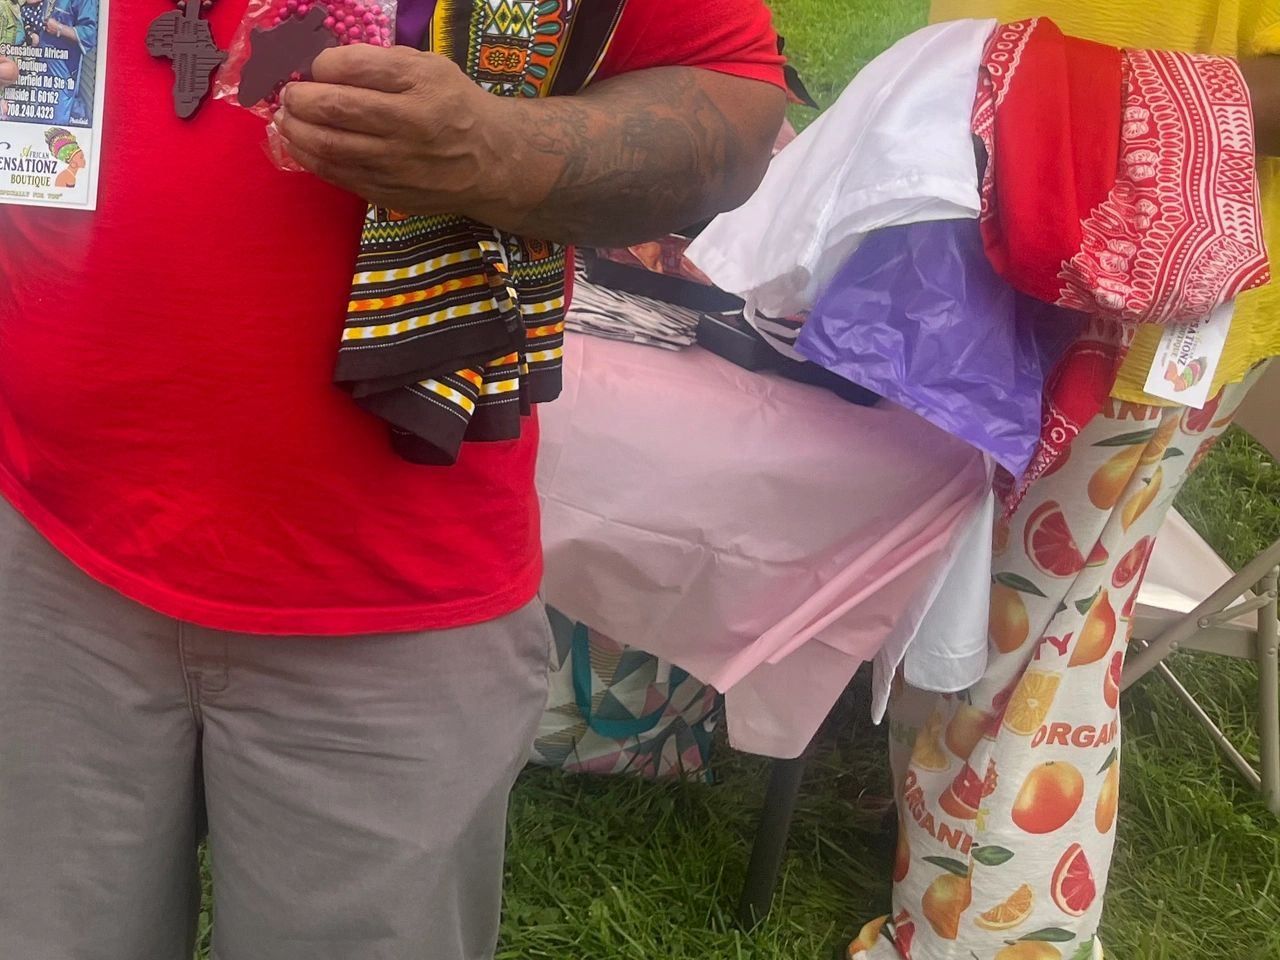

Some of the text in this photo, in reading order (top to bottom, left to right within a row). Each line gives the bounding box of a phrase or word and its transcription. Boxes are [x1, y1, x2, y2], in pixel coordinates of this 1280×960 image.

[44, 47, 69, 59] African
[17, 59, 48, 73] Boutique
[43, 76, 53, 88] Rd
[54, 76, 65, 90] Ste
[4, 87, 29, 102] Hillside
[37, 91, 59, 104] 60162
[7, 103, 54, 119] 708.240.4323
[20, 145, 49, 159] AFRICAN
[10, 174, 51, 188] BOUTIQUE
